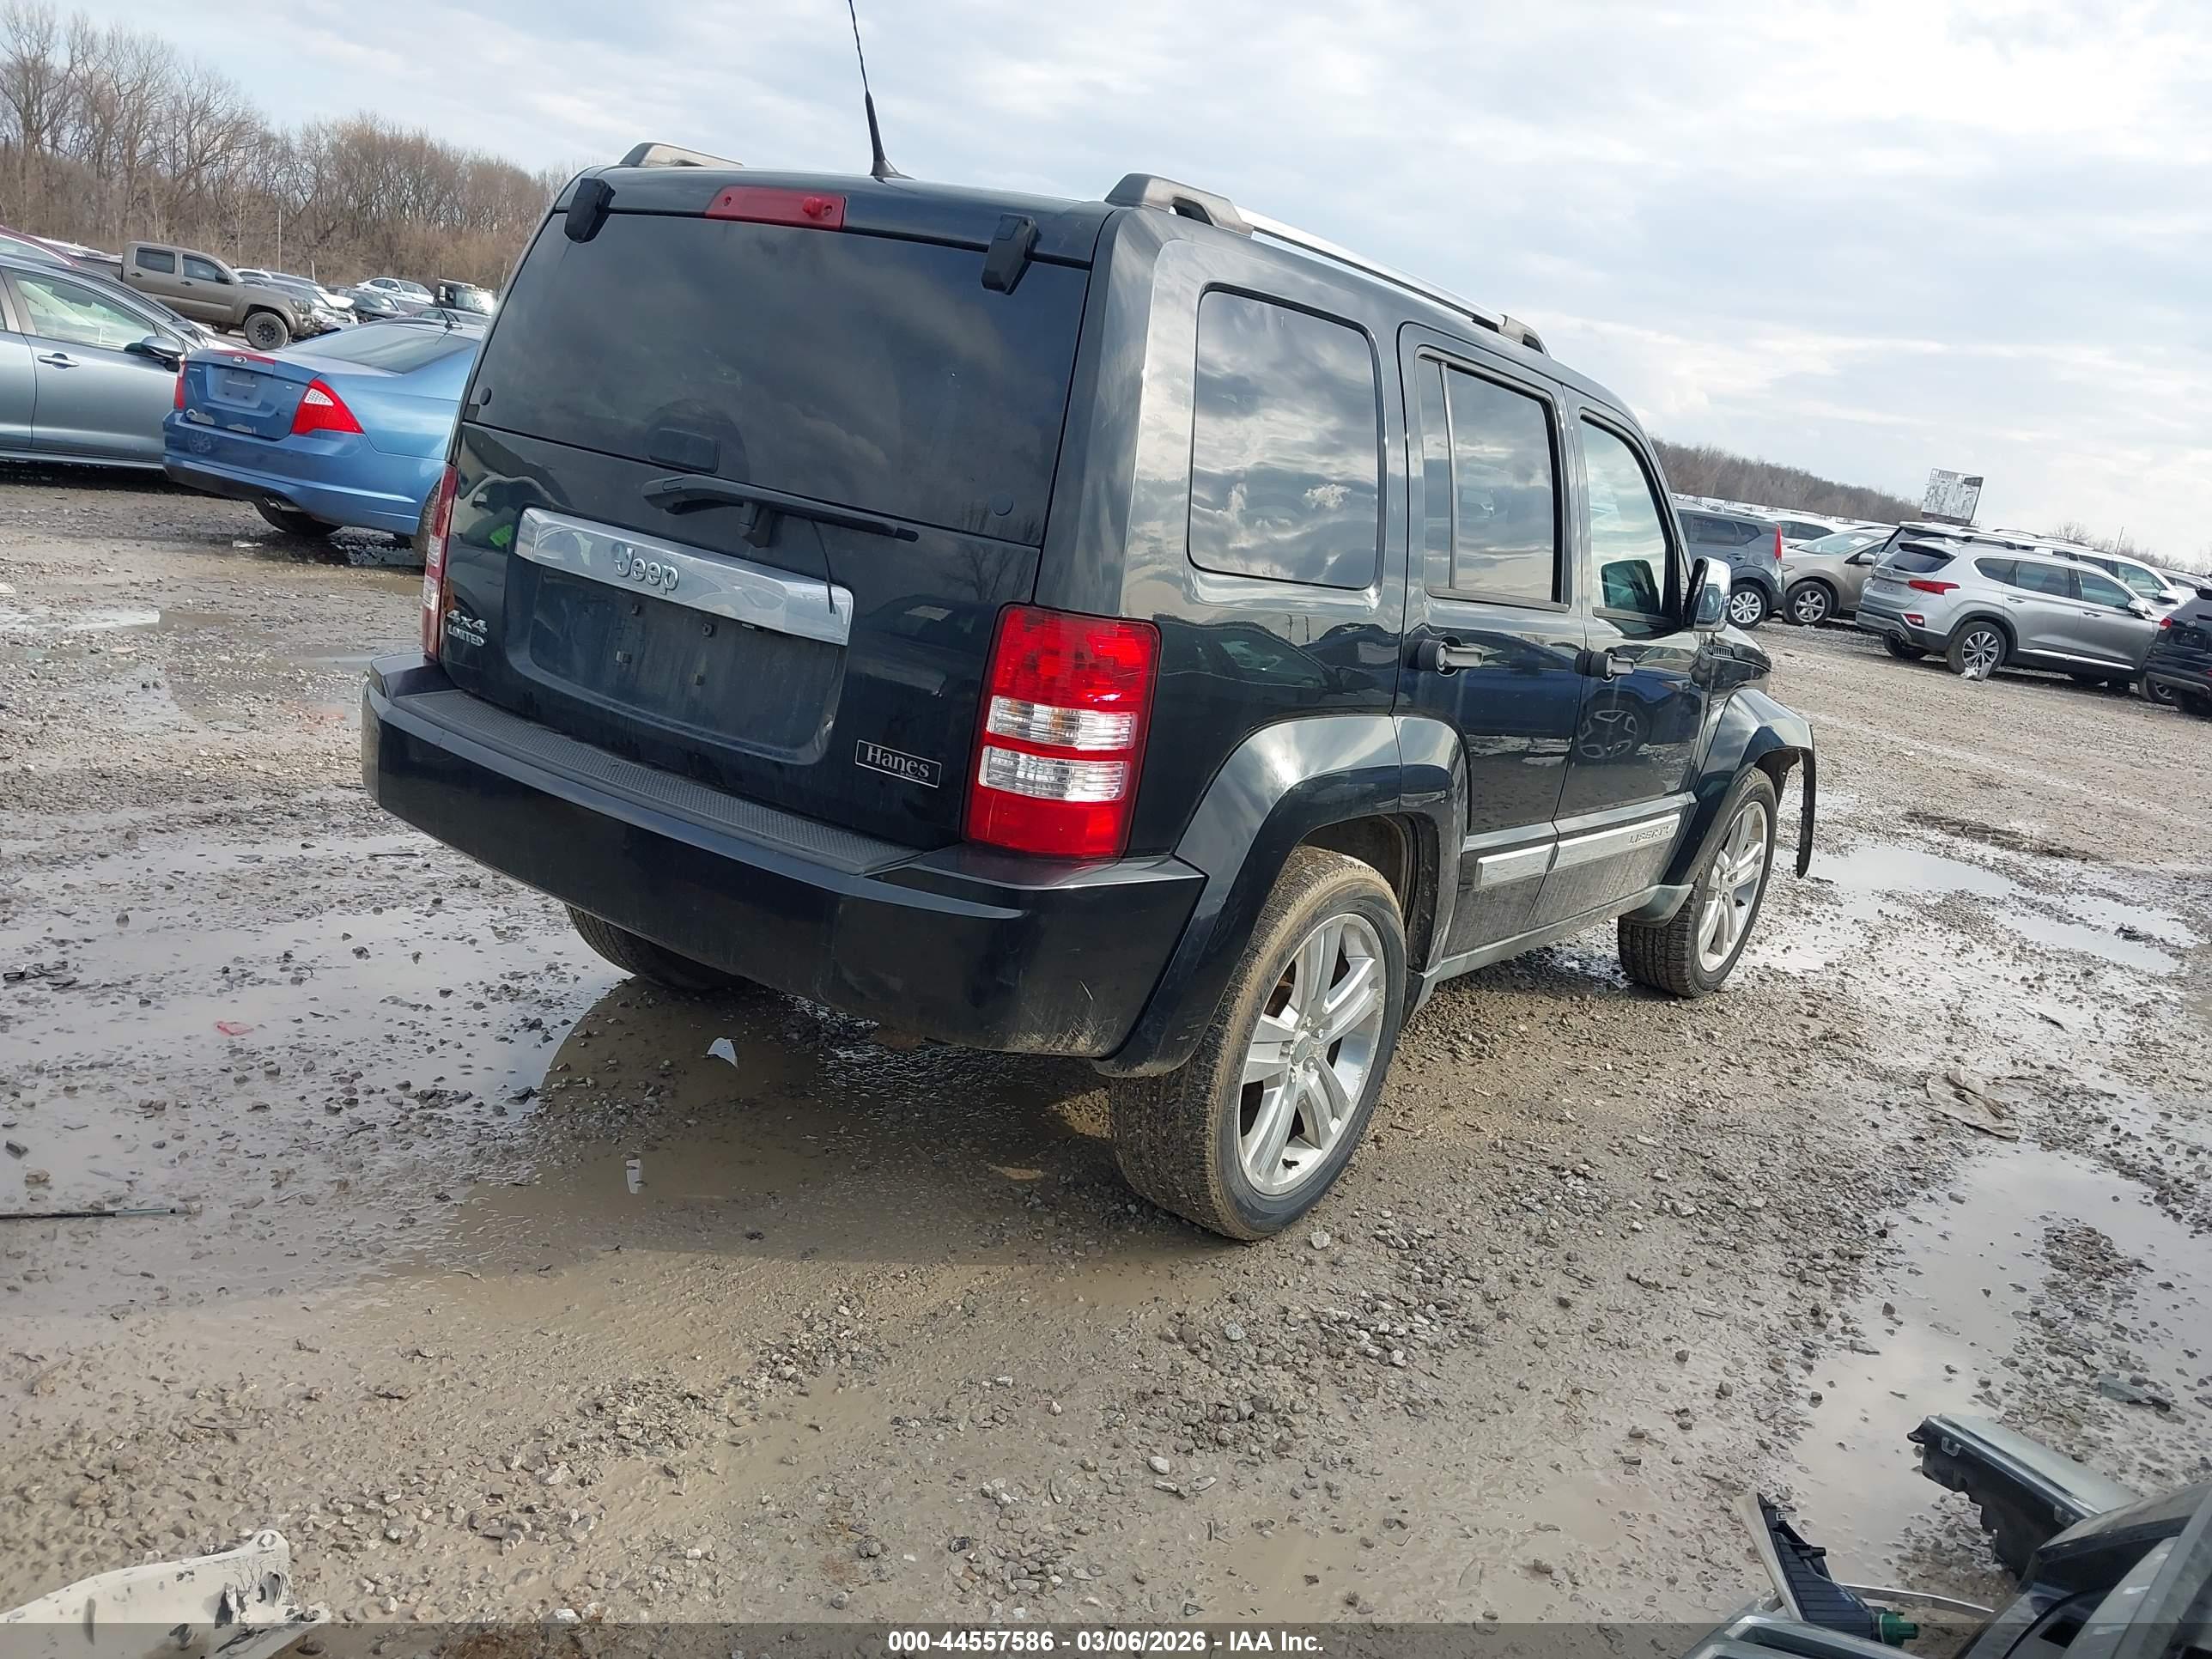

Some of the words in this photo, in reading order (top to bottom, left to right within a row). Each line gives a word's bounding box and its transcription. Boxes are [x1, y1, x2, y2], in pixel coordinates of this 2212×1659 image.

[614, 547, 679, 596] Jeep
[447, 624, 485, 647] LIMITED
[866, 744, 929, 778] Hanes
